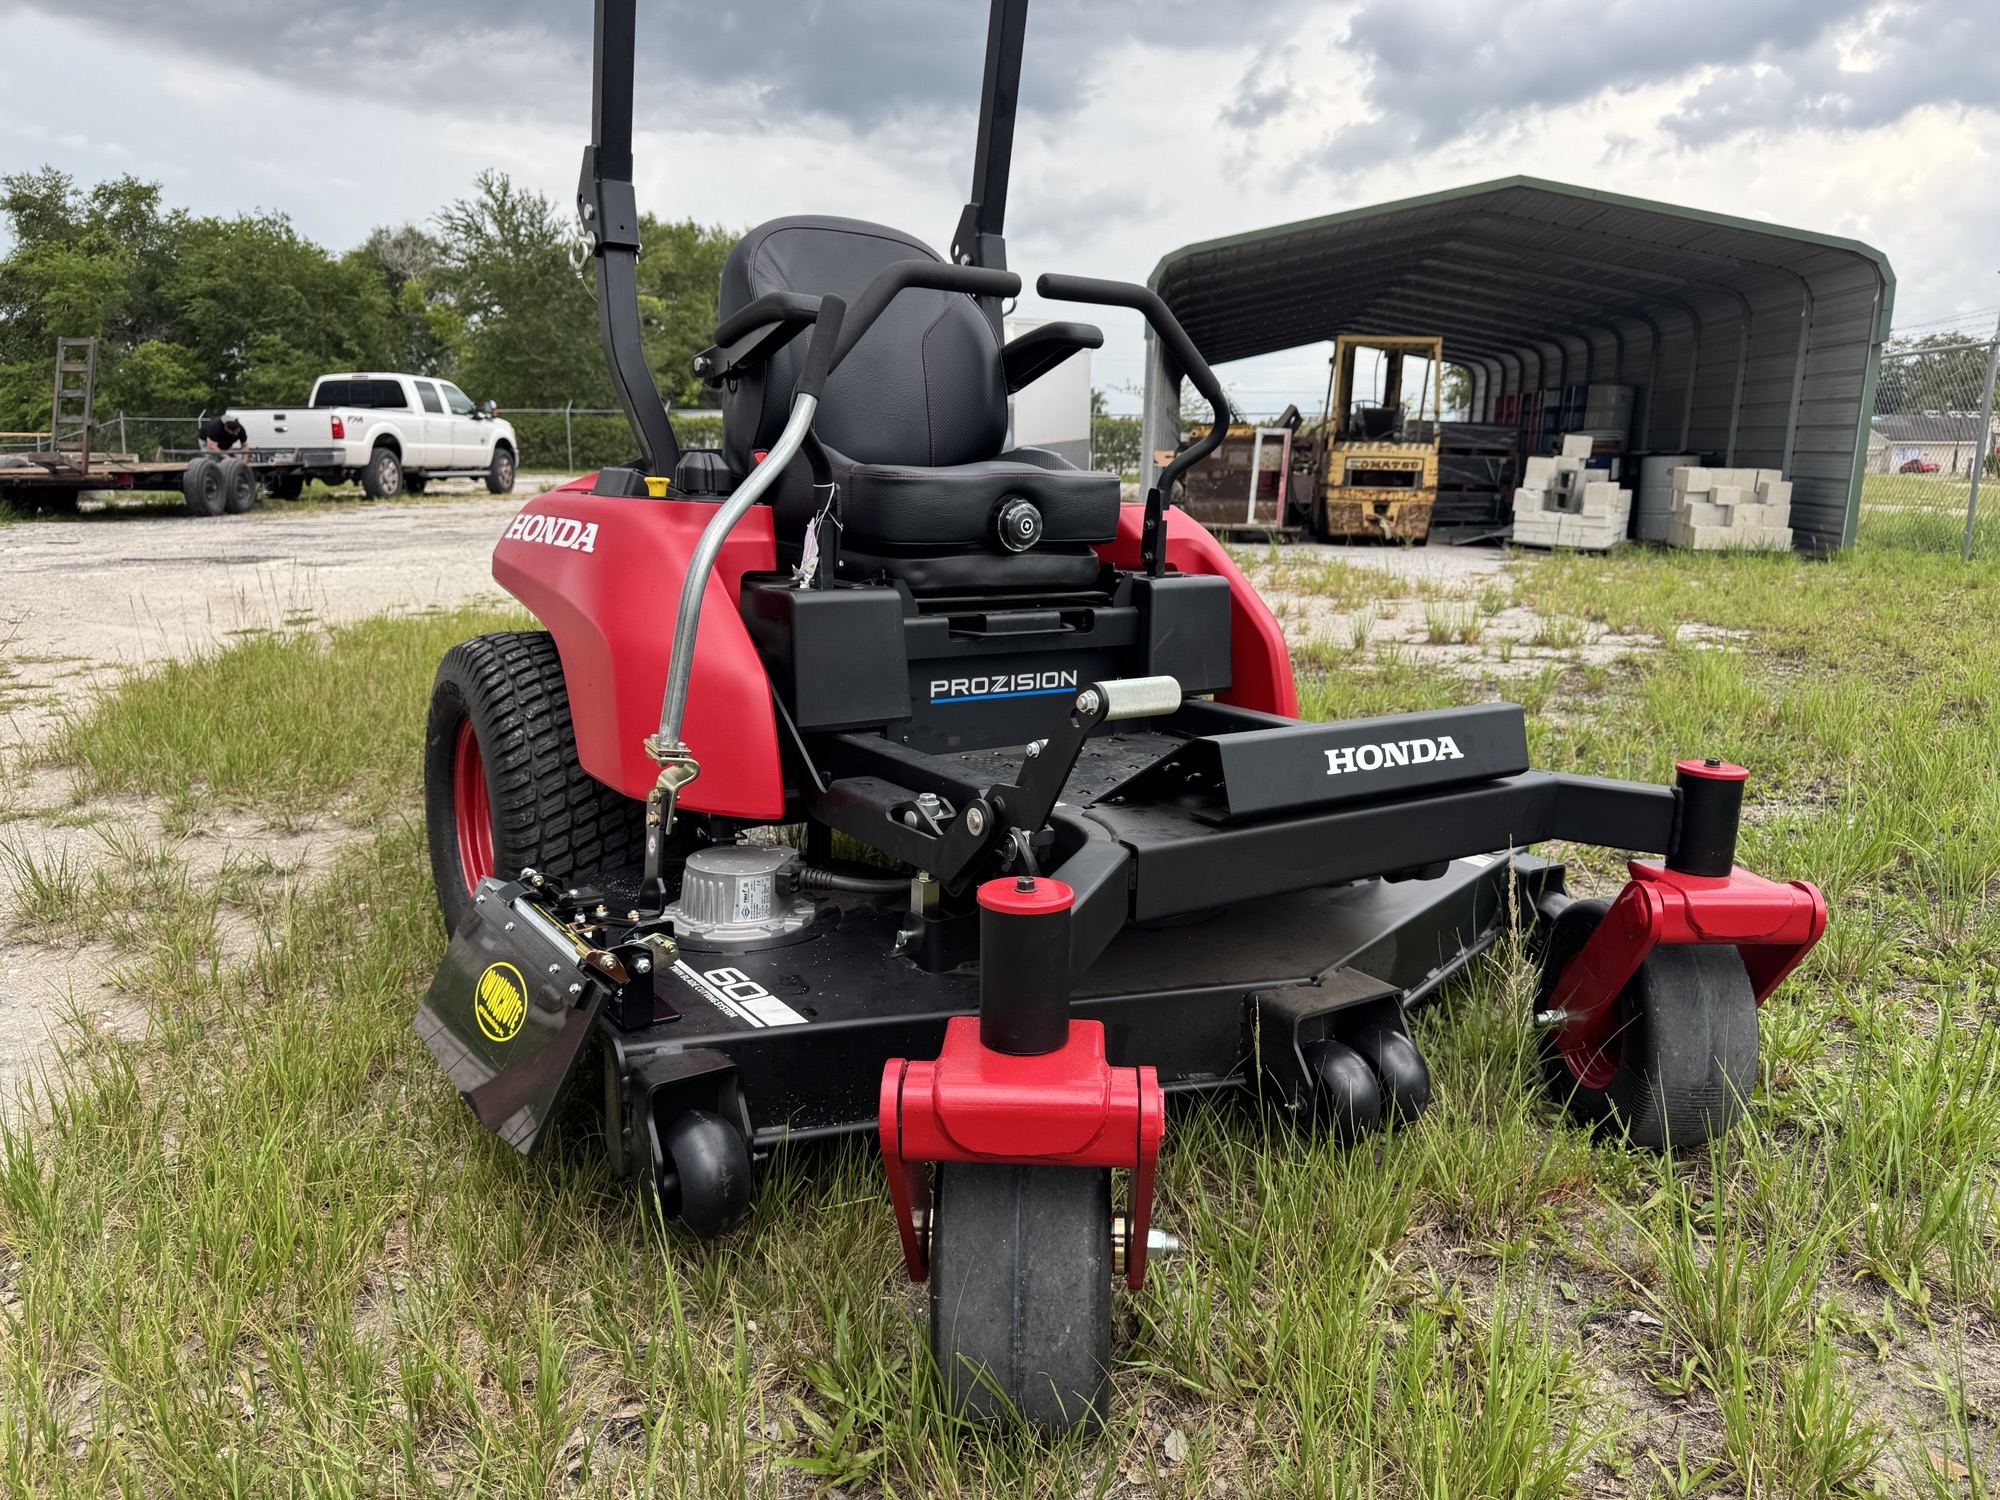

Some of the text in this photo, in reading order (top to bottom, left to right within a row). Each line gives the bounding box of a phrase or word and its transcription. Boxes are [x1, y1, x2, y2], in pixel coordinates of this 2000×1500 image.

[505, 514, 599, 553] HONDA
[931, 670, 1077, 698] PROZISION
[1324, 736, 1464, 775] HONDA
[703, 967, 769, 1001] 60
